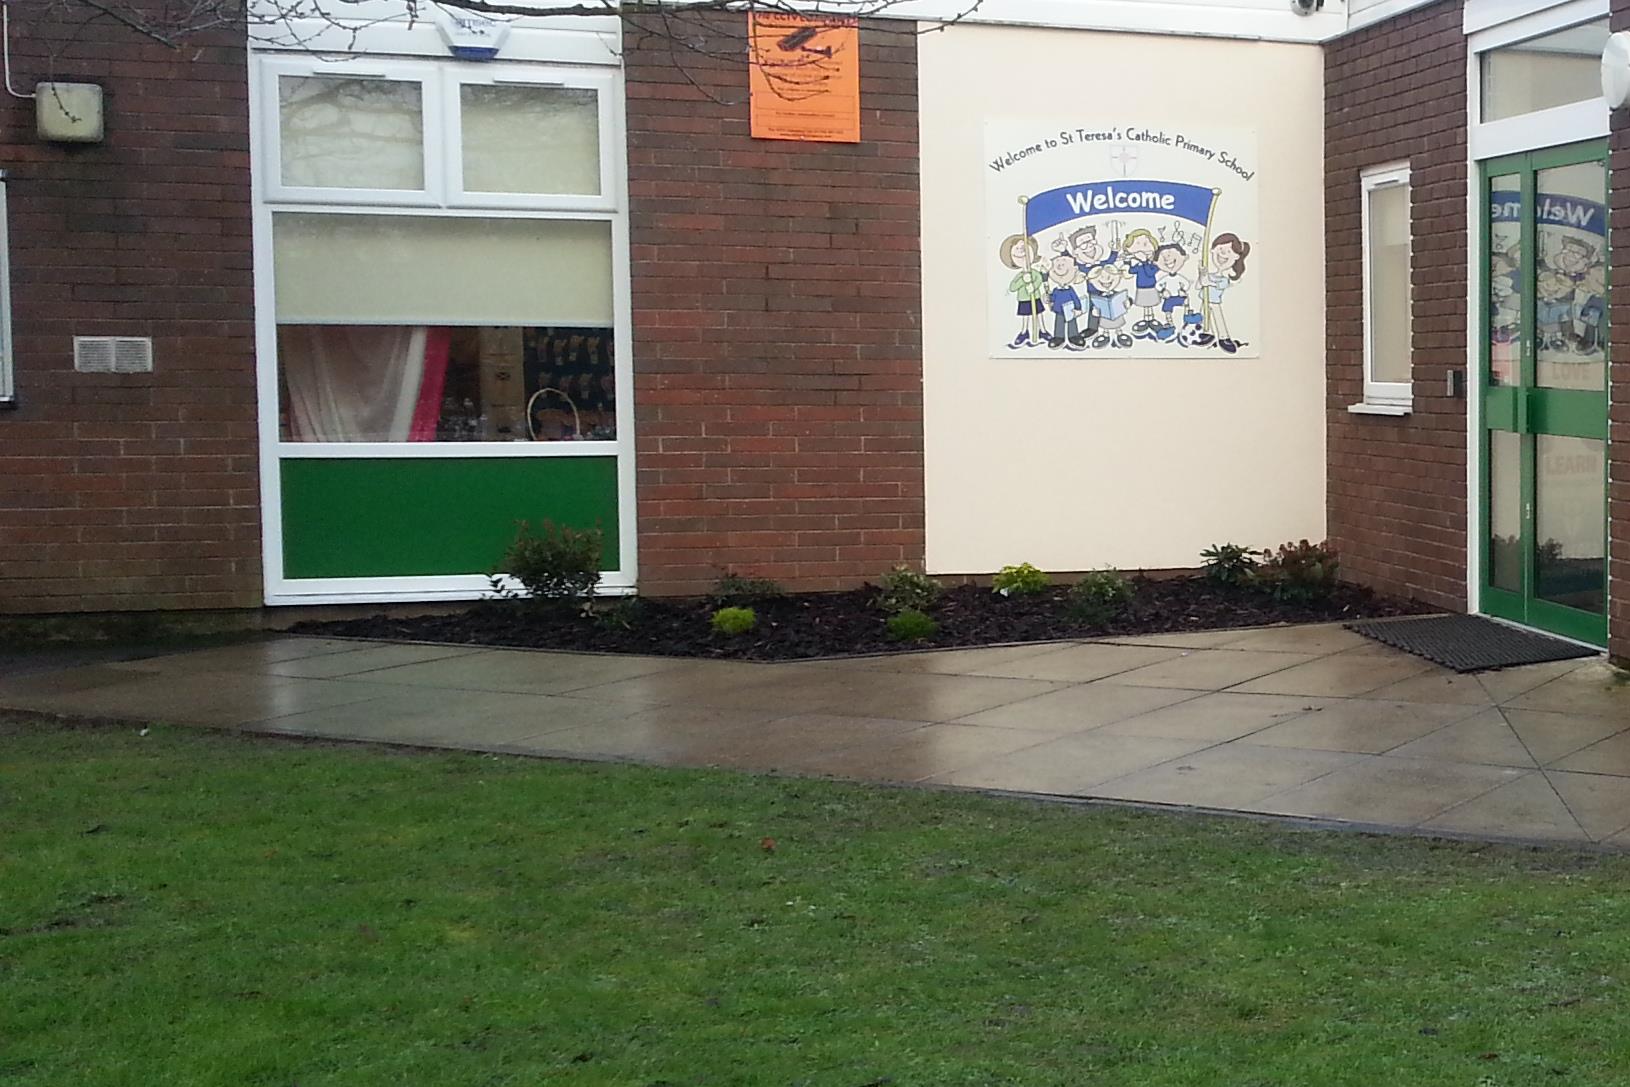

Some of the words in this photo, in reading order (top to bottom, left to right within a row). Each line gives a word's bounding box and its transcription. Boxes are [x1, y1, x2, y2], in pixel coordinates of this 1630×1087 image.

[988, 143, 1042, 172] Welcome
[1045, 139, 1058, 149] to
[1060, 131, 1074, 145] St
[1076, 127, 1122, 142] Teresa's
[1126, 127, 1171, 146] Catholic
[1175, 134, 1216, 160] Primary
[1218, 151, 1255, 181] School
[1065, 186, 1175, 215] Welcome
